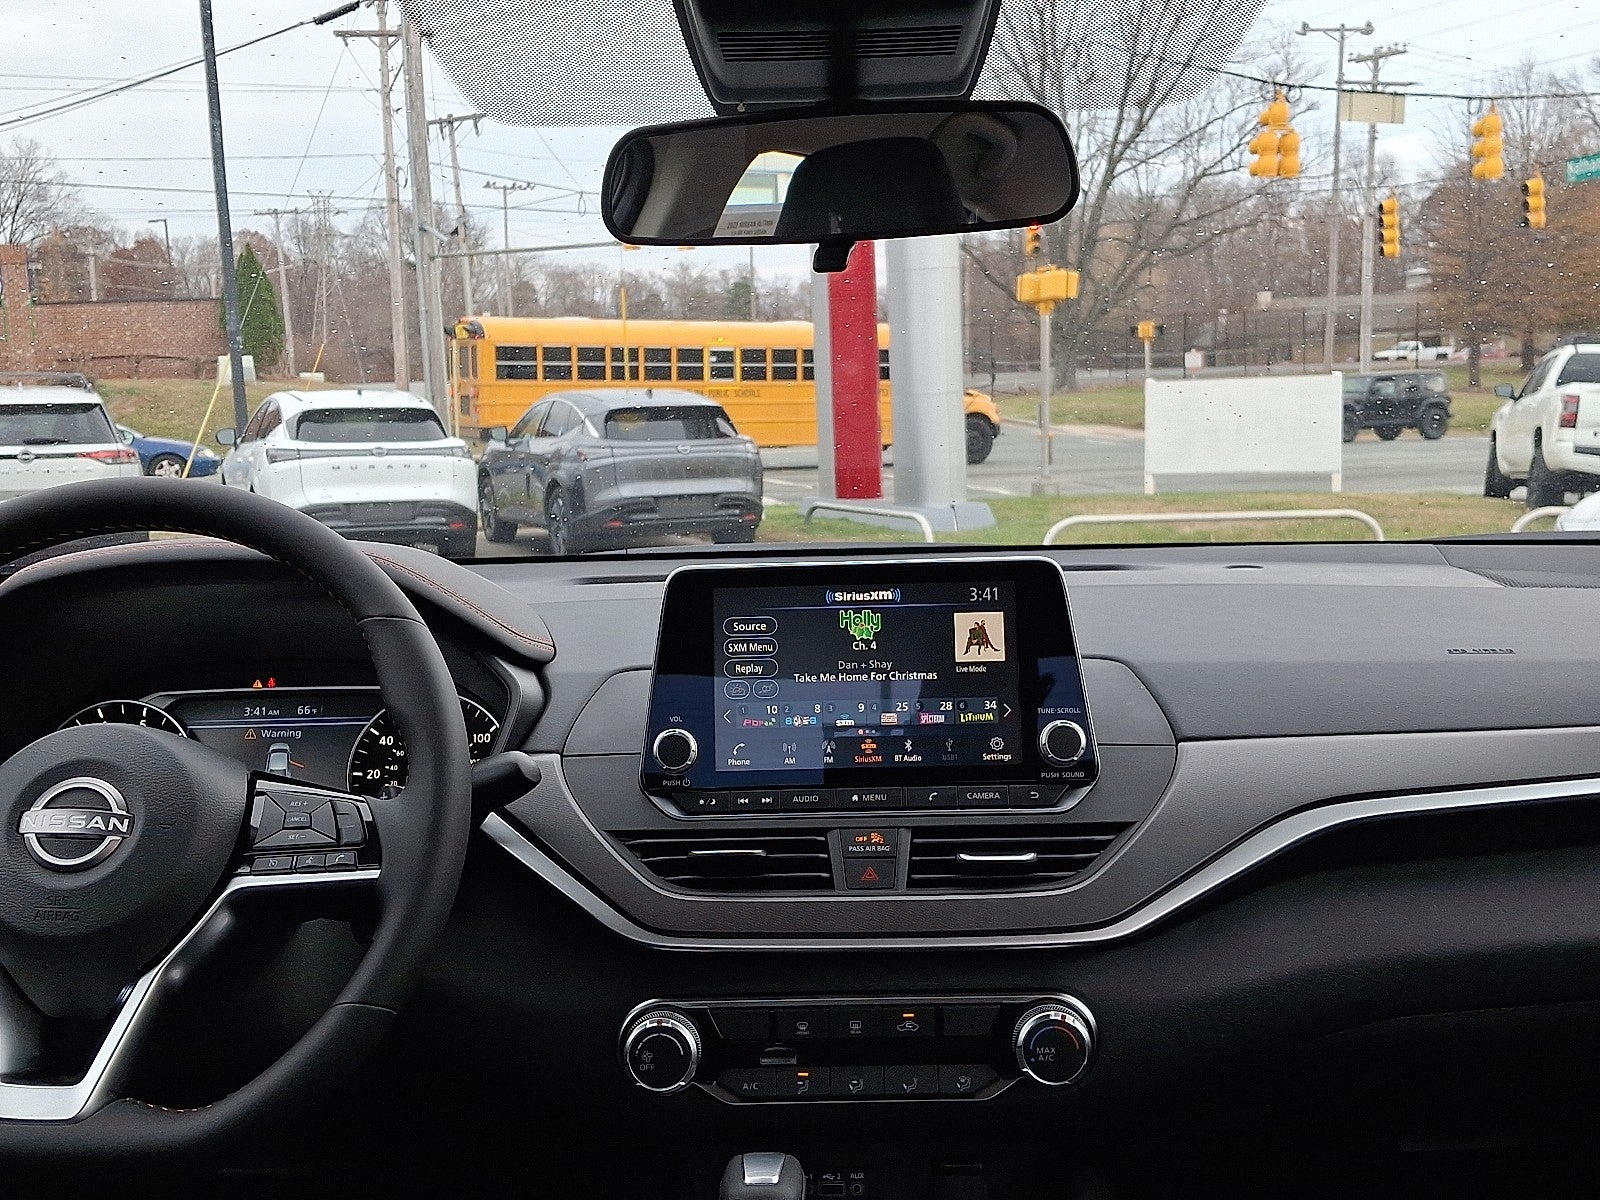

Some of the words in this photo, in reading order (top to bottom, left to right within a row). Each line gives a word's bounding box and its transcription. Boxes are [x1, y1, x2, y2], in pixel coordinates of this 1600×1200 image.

[734, 389, 760, 398] SCHOOLS
[969, 587, 999, 602] 3:41
[839, 609, 882, 632] Holly
[733, 622, 767, 632] Source
[728, 643, 747, 653] SXM
[749, 642, 773, 652] Menu
[852, 641, 868, 651] Ch.
[870, 641, 877, 650] 4
[735, 664, 763, 675] Replay
[838, 661, 858, 670] Dan
[869, 660, 893, 671] Shay
[793, 673, 817, 683] Take
[820, 673, 836, 682] Me
[838, 672, 868, 682] Home
[870, 672, 887, 681] For
[889, 671, 938, 681] Christmas
[766, 705, 778, 715] 10
[814, 704, 821, 714] 8
[857, 703, 865, 712] 9
[871, 703, 877, 711] 4
[896, 702, 909, 712] 25
[939, 701, 953, 711] 28
[983, 700, 998, 710] 34
[244, 706, 266, 717] 3:41
[261, 729, 302, 739] Warning
[472, 733, 491, 743] 100
[379, 735, 393, 745] 40
[728, 758, 751, 766] Phone
[784, 757, 796, 765] AM
[824, 756, 834, 764] FM
[982, 753, 1012, 762] Settings
[366, 769, 380, 779] 20
[792, 795, 819, 803] AUDIO
[862, 793, 887, 802] MENU
[966, 792, 1000, 800] CAMERA
[22, 814, 130, 833] NISSAN
[33, 909, 80, 922] AIRBAG
[1036, 1046, 1056, 1054] MAX
[1038, 1054, 1056, 1062] A/C
[639, 1063, 655, 1071] OFF
[742, 1082, 760, 1090] A/C
